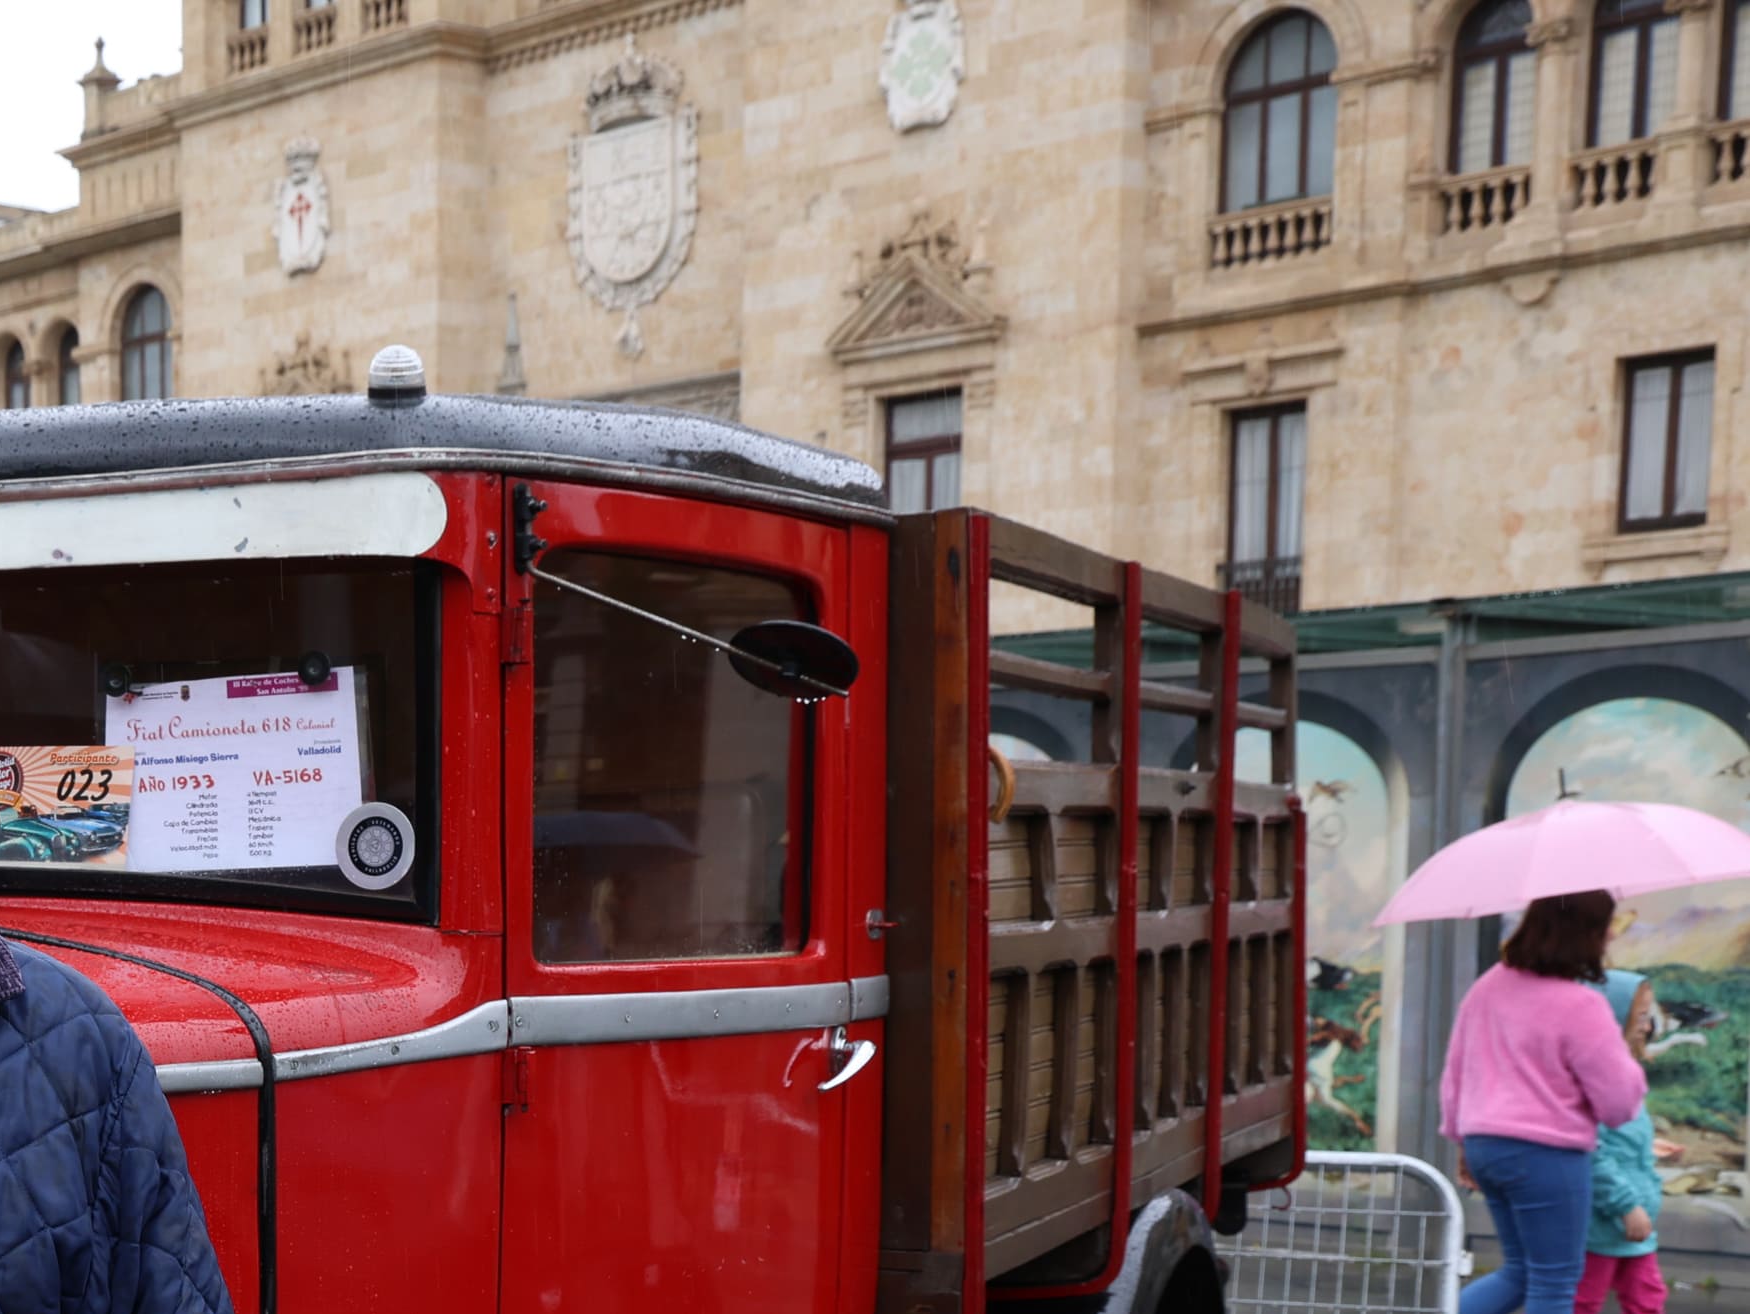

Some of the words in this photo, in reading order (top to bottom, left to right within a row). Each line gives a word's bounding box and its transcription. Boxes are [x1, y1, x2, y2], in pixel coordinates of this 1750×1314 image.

[126, 718, 164, 743] Fiat
[168, 715, 257, 740] Camioneta
[262, 716, 292, 734] 618
[141, 755, 174, 766] Alfonso
[210, 752, 239, 762] Sierra
[298, 745, 341, 756] Valladolid
[50, 752, 119, 767] Participante
[56, 768, 113, 802] 023
[171, 774, 215, 791] 1933
[252, 768, 322, 786] VA-5168
